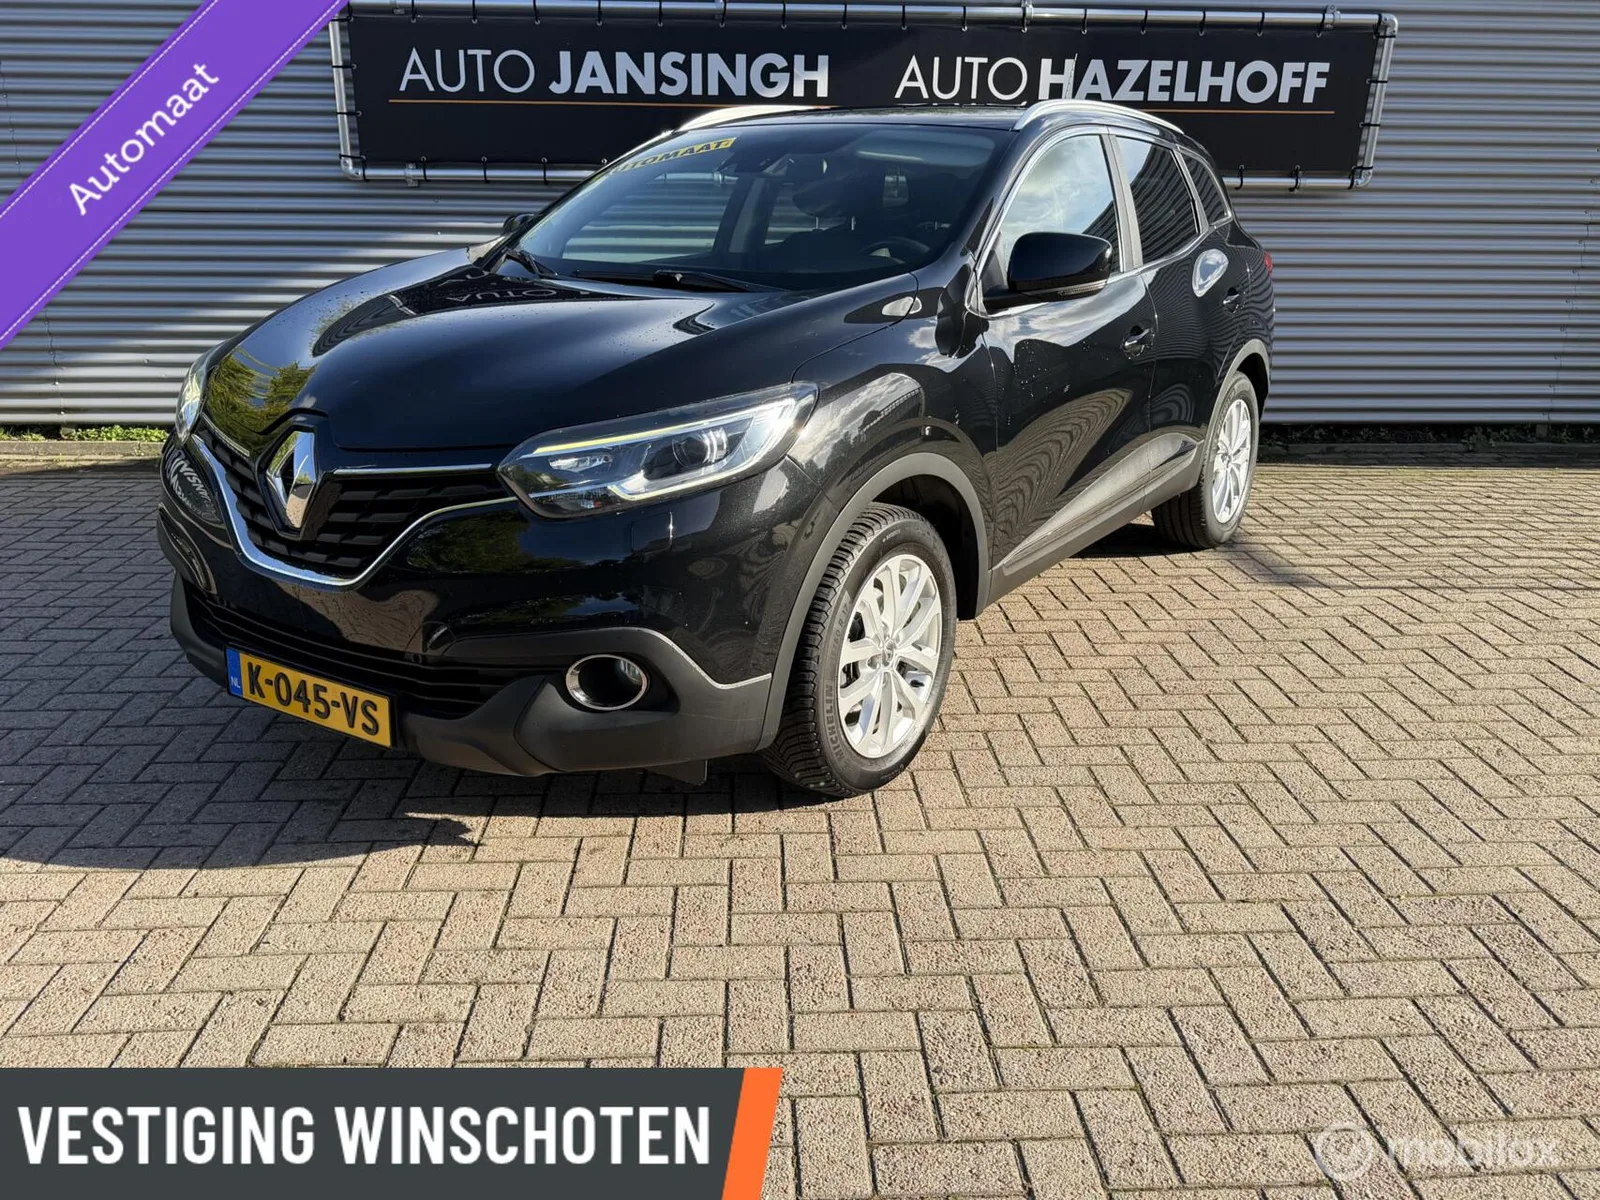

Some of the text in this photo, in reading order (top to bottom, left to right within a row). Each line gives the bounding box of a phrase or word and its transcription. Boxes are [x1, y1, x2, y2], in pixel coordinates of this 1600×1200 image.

[399, 47, 829, 98] AUTO JANSINGH
[895, 55, 1331, 103] AUTO HAZELHOFF
[230, 676, 241, 689] NL
[247, 661, 380, 736] K-045-VS
[825, 684, 846, 760] MICHELIN
